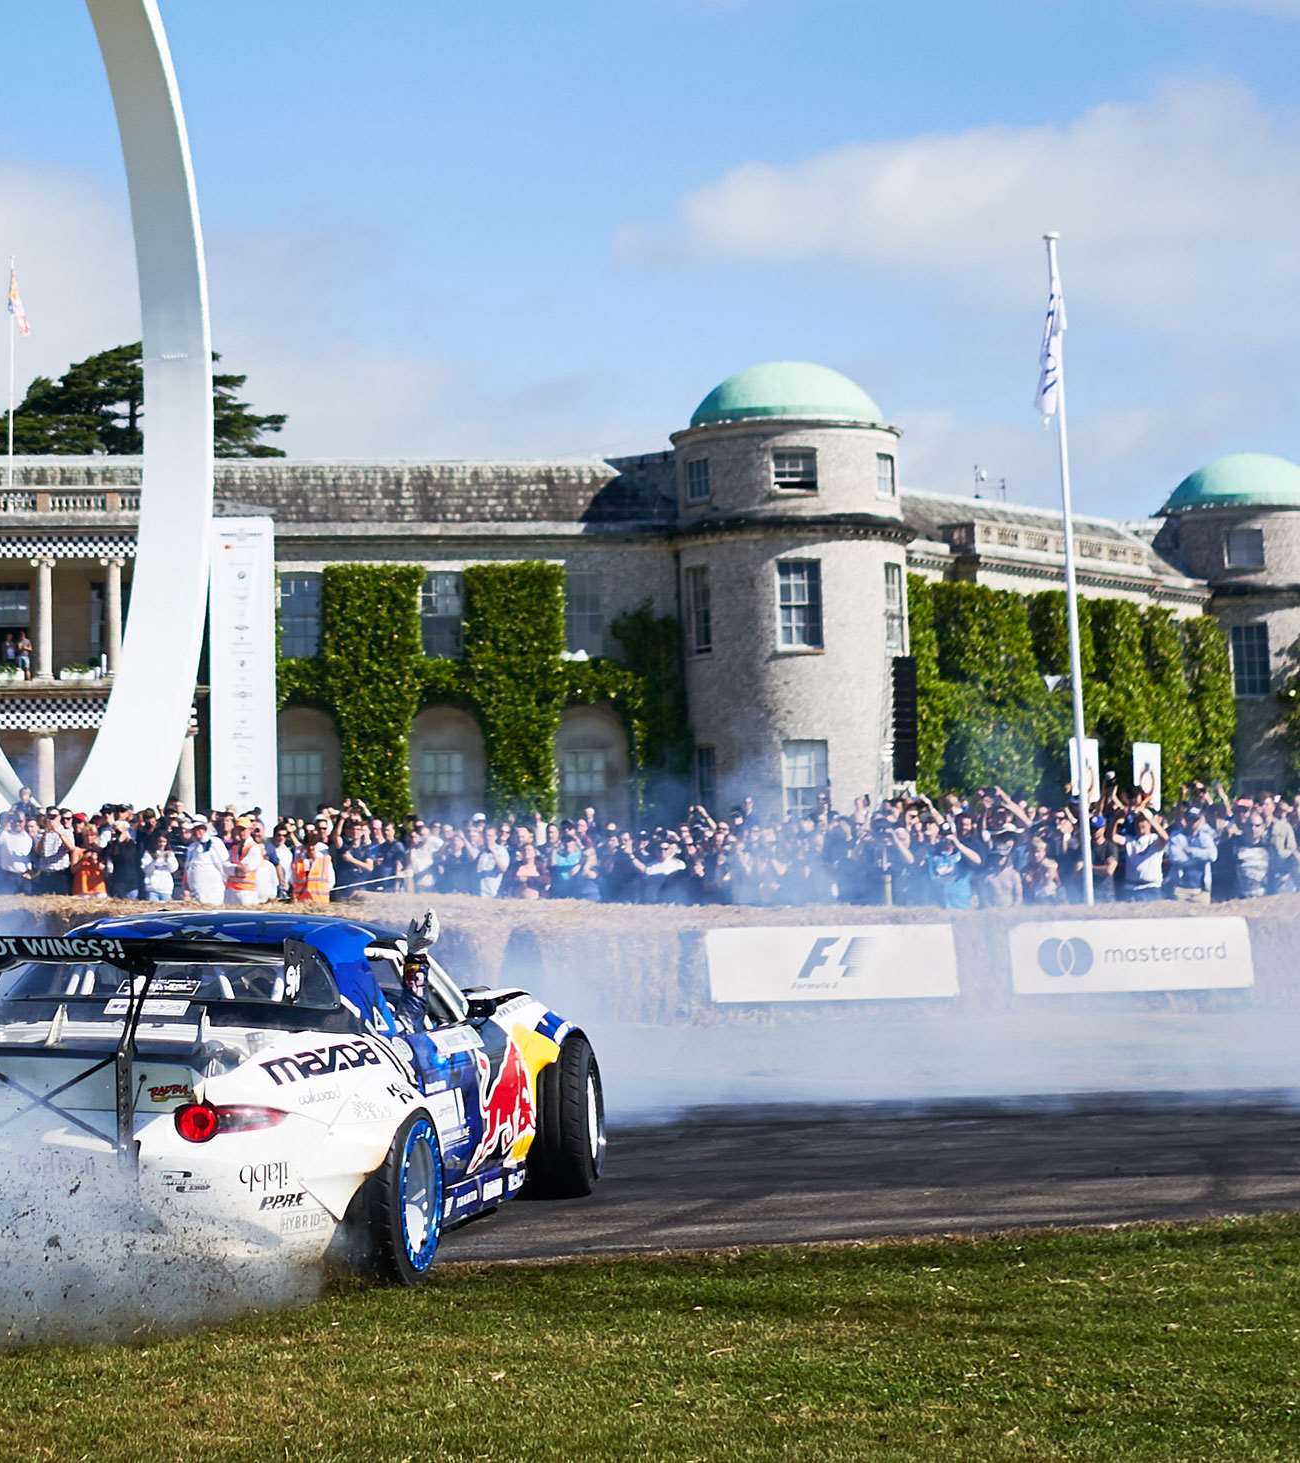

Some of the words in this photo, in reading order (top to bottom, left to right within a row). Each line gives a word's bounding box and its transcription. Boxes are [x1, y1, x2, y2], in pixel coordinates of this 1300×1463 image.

[22, 937, 126, 959] WINGS?!
[797, 936, 872, 978] F1
[1103, 941, 1228, 964] mastercard
[258, 1040, 381, 1086] mazda
[281, 1213, 321, 1232] HYBRID
